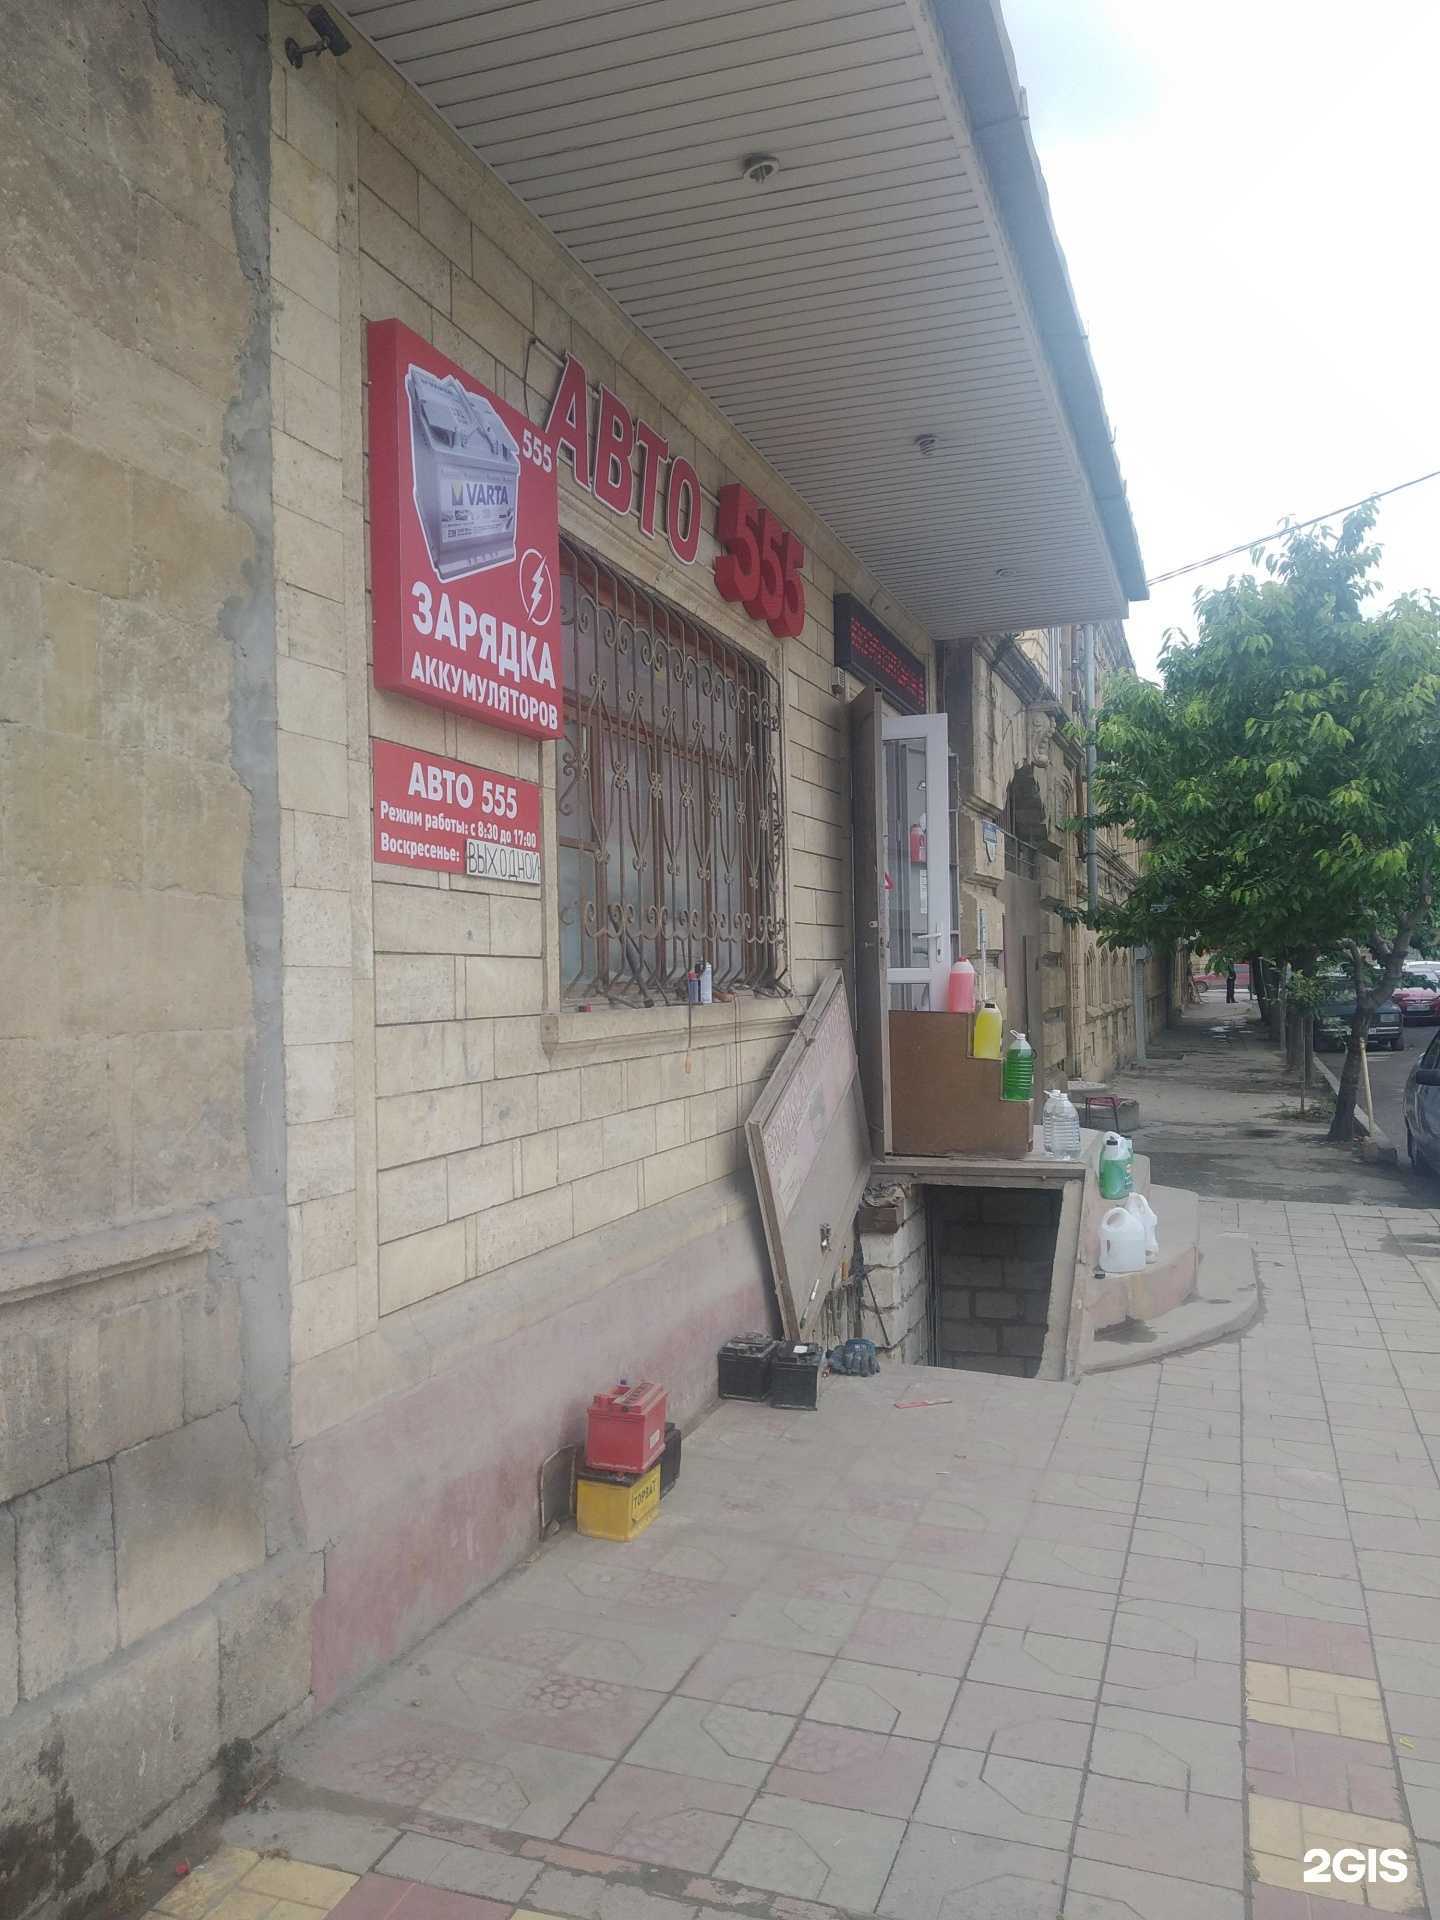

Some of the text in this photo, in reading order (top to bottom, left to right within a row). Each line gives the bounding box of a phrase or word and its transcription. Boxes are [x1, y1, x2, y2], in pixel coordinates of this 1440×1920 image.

[522, 429, 553, 474] 555
[466, 482, 509, 506] VARTA
[545, 352, 806, 639] АВТО 555
[411, 581, 557, 689] ЗАРЯДКА
[411, 651, 558, 730] АККУМУЛЯТОРОВ
[408, 762, 518, 819] АВТО 555
[380, 800, 422, 827] Режим
[425, 812, 469, 836] работы:
[477, 821, 499, 841] 8:30
[500, 831, 512, 845] до
[513, 828, 537, 848] 17:00
[380, 832, 460, 863] Воскресенье:
